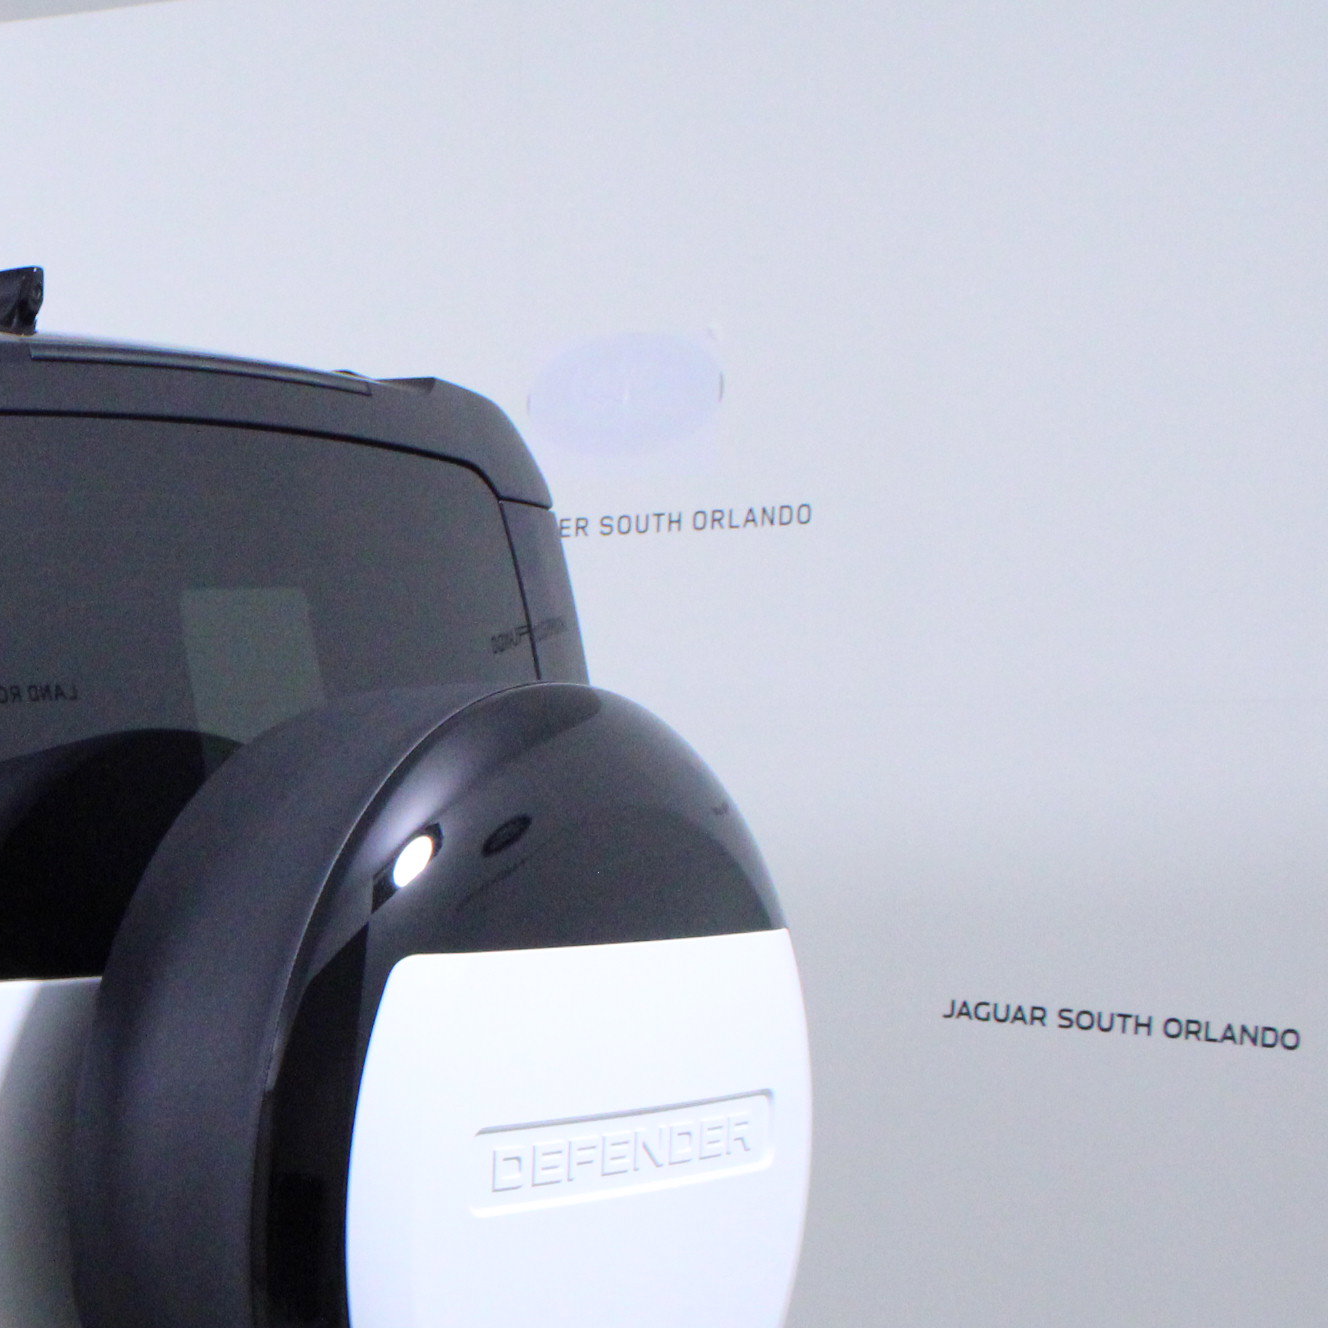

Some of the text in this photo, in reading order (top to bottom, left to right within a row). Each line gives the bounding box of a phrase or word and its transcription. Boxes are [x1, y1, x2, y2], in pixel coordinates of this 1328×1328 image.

[599, 511, 683, 537] SOUTH
[691, 502, 813, 532] ORLANDO
[942, 999, 1302, 1052] JAGUAR SOUTH ORLANDO
[490, 1111, 752, 1194] DEFENDER
